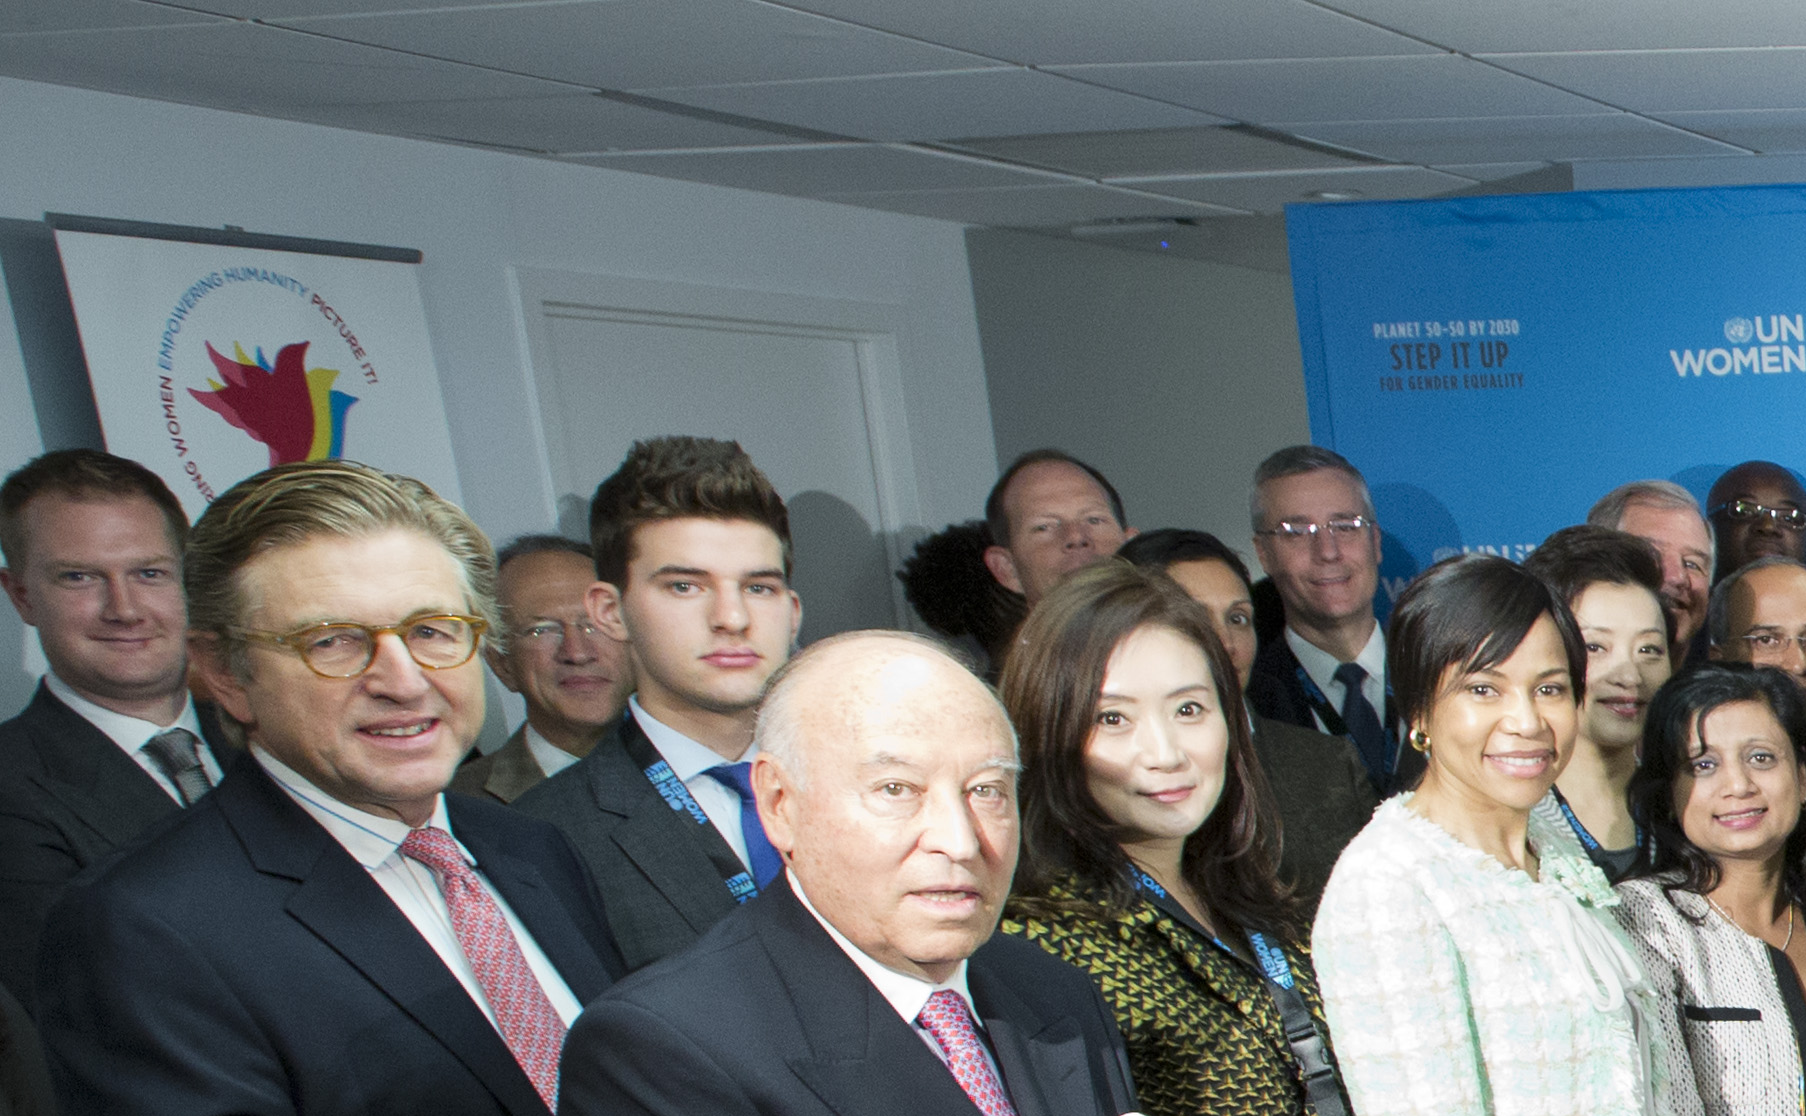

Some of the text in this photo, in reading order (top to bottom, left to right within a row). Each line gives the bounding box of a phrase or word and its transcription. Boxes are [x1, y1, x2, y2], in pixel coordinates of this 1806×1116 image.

[222, 266, 309, 298] HUMANITY
[158, 271, 224, 371] EMPOWERING
[311, 293, 367, 361] PICTURE
[1373, 319, 1520, 338] PLANET 50-50 BY 2030
[1755, 314, 1805, 343] UN
[1390, 340, 1509, 370] STEP IT UP
[1669, 345, 1806, 377] WOMEN
[1380, 373, 1523, 391] FOR GENDER EQUALITY
[159, 375, 190, 458] WOMEN
[667, 776, 708, 825] WOMEN
[1251, 932, 1278, 978] WOMEN
